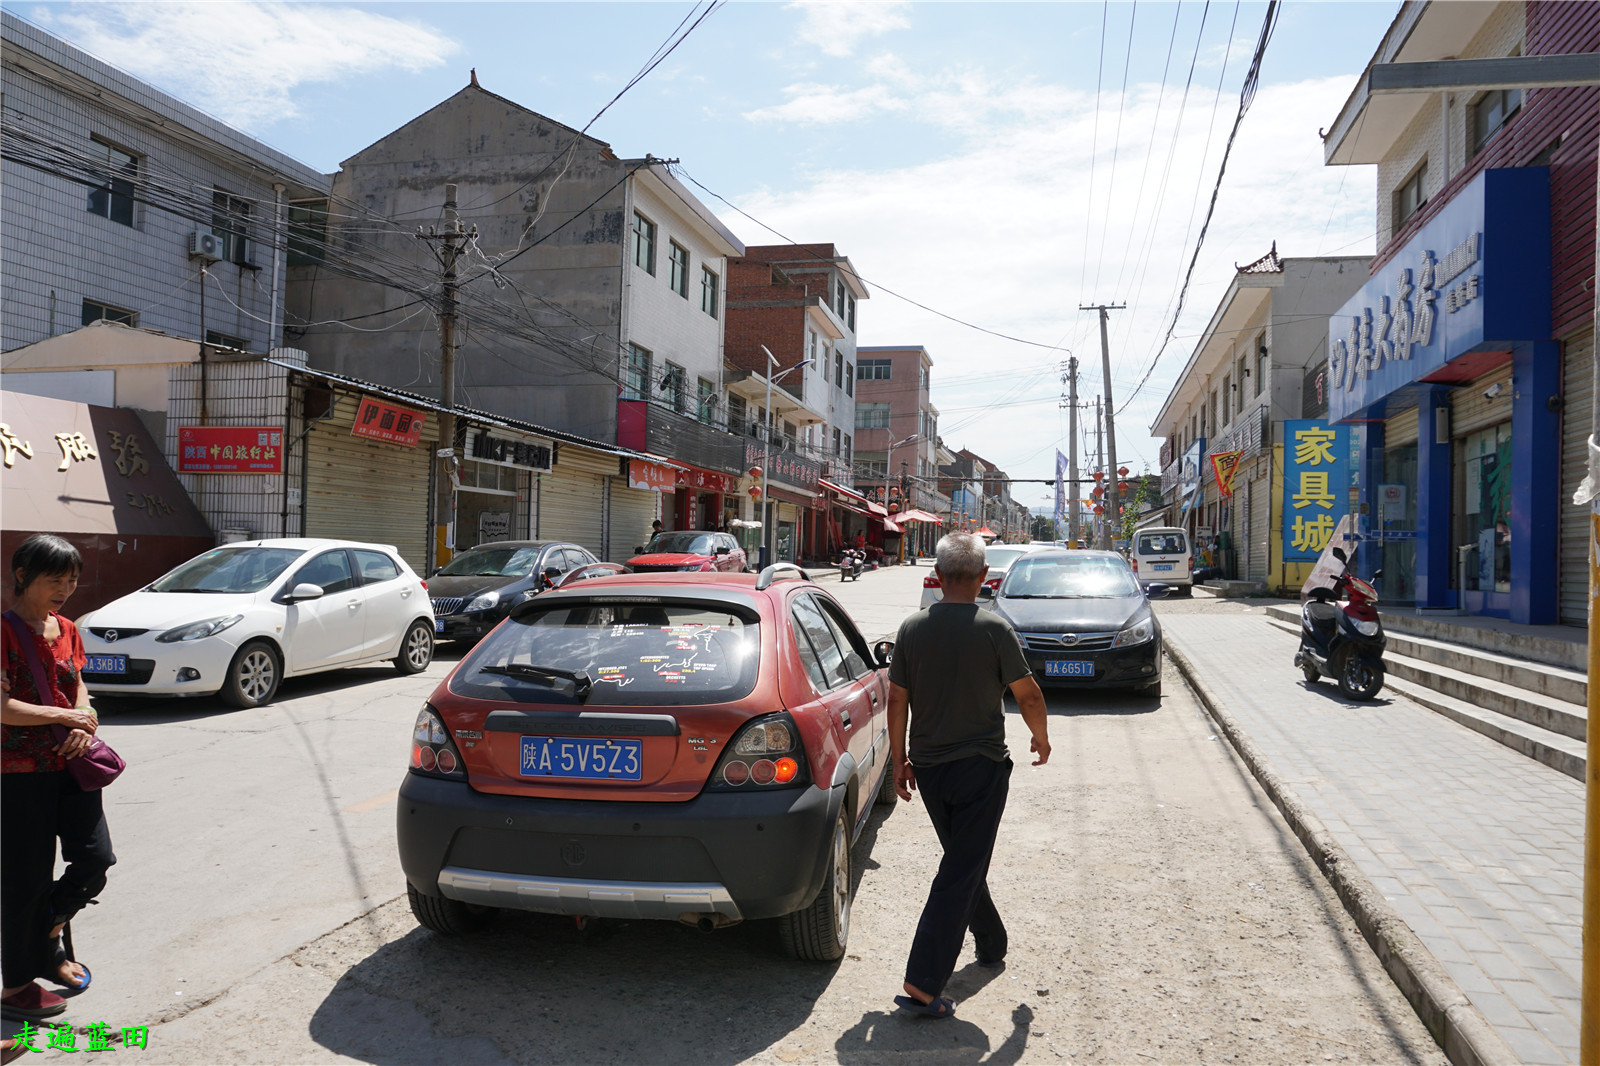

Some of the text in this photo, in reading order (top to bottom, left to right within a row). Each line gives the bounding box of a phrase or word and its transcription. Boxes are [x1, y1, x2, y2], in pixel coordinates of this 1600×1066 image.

[1291, 427, 1336, 552] 家具城
[84, 658, 124, 671] A·3KB13
